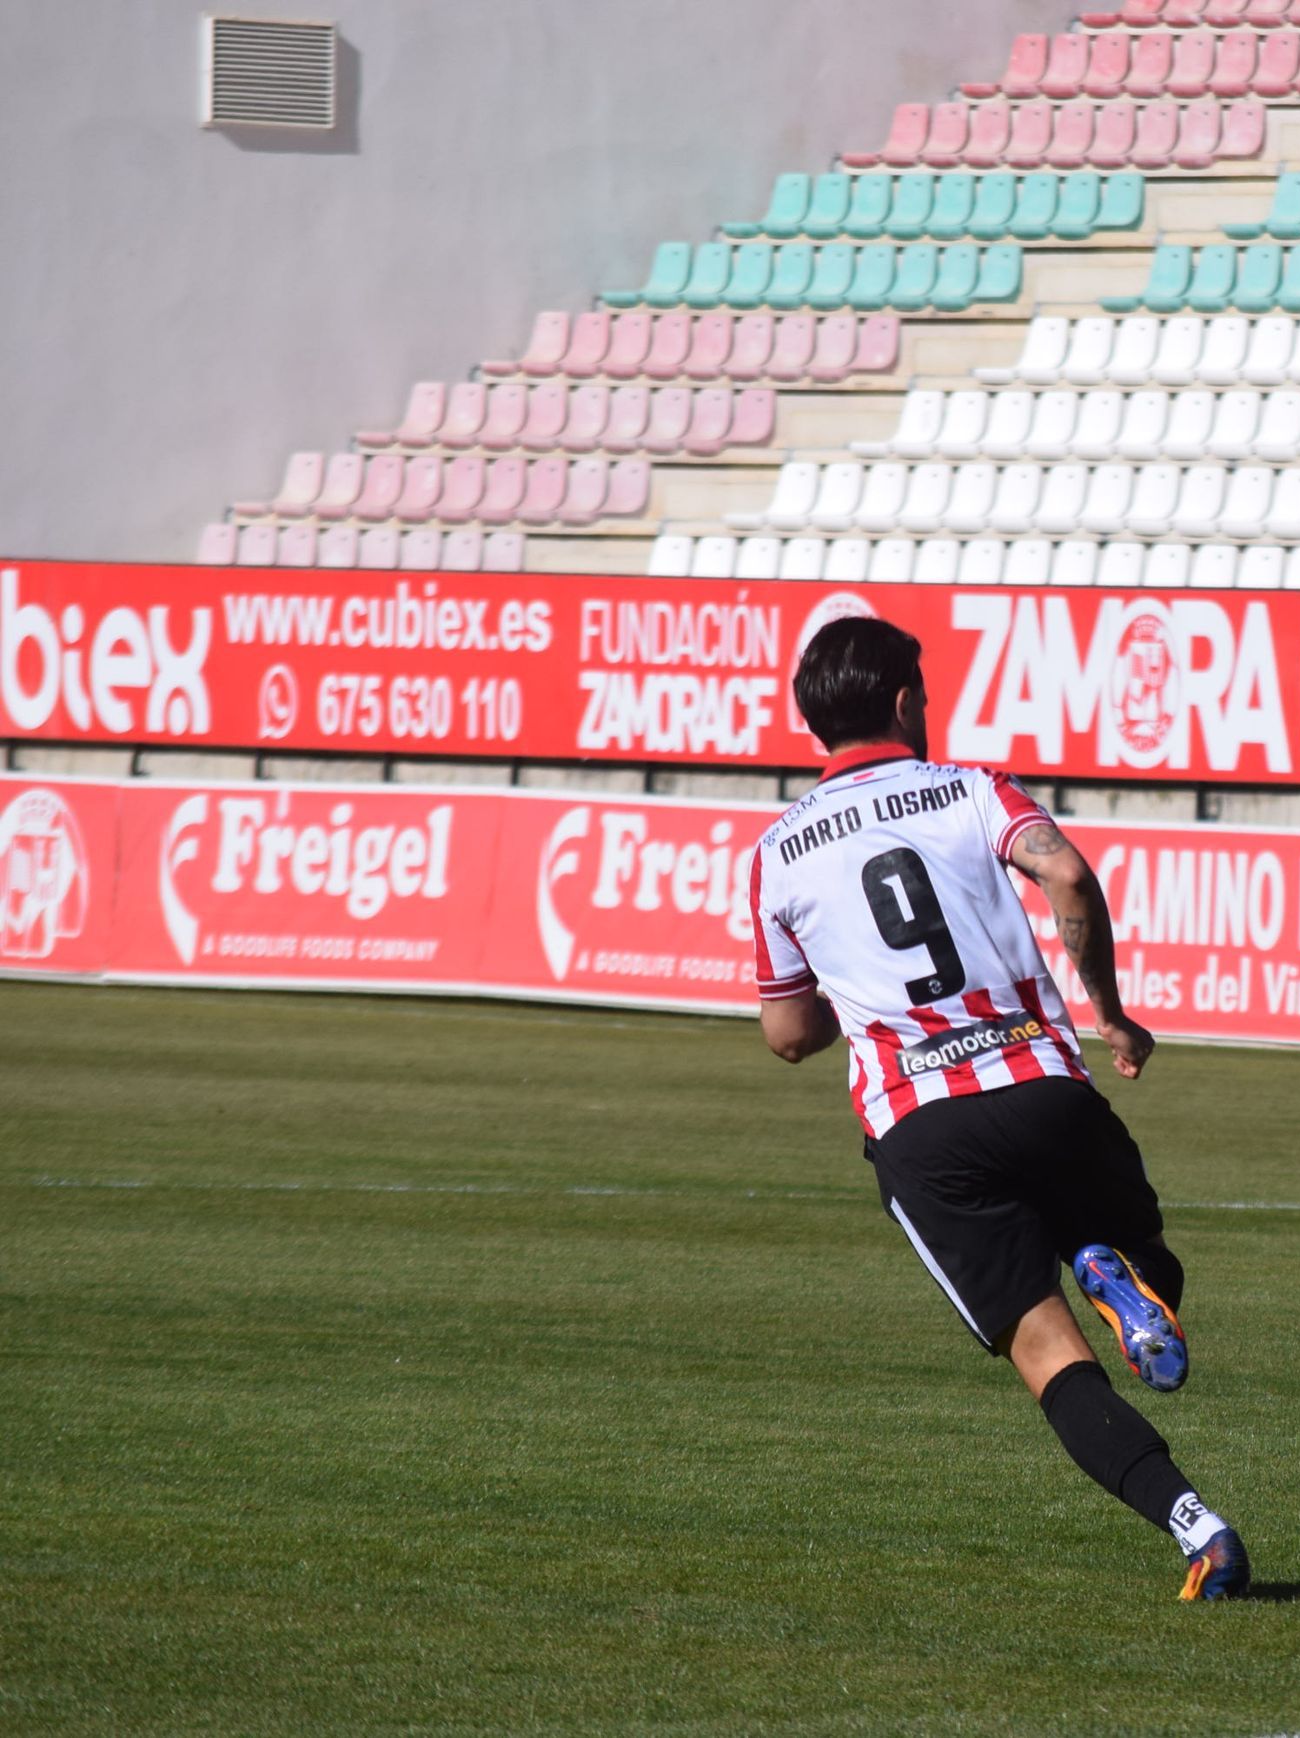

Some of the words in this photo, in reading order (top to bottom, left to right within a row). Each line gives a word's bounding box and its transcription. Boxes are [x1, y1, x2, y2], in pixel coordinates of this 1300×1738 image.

[222, 580, 552, 652] www.cubiex.es
[579, 589, 781, 668] FUNDACIÓN
[316, 673, 382, 735] 675
[388, 677, 453, 738] 630
[460, 677, 521, 740] 110
[946, 593, 1292, 774] ZAMORA
[212, 795, 454, 919] Freigel
[779, 805, 863, 866] MARIO
[873, 778, 968, 823] LOSADA
[861, 847, 966, 1006] 9
[1096, 844, 1286, 951] CAMINO
[1194, 954, 1252, 1014] del
